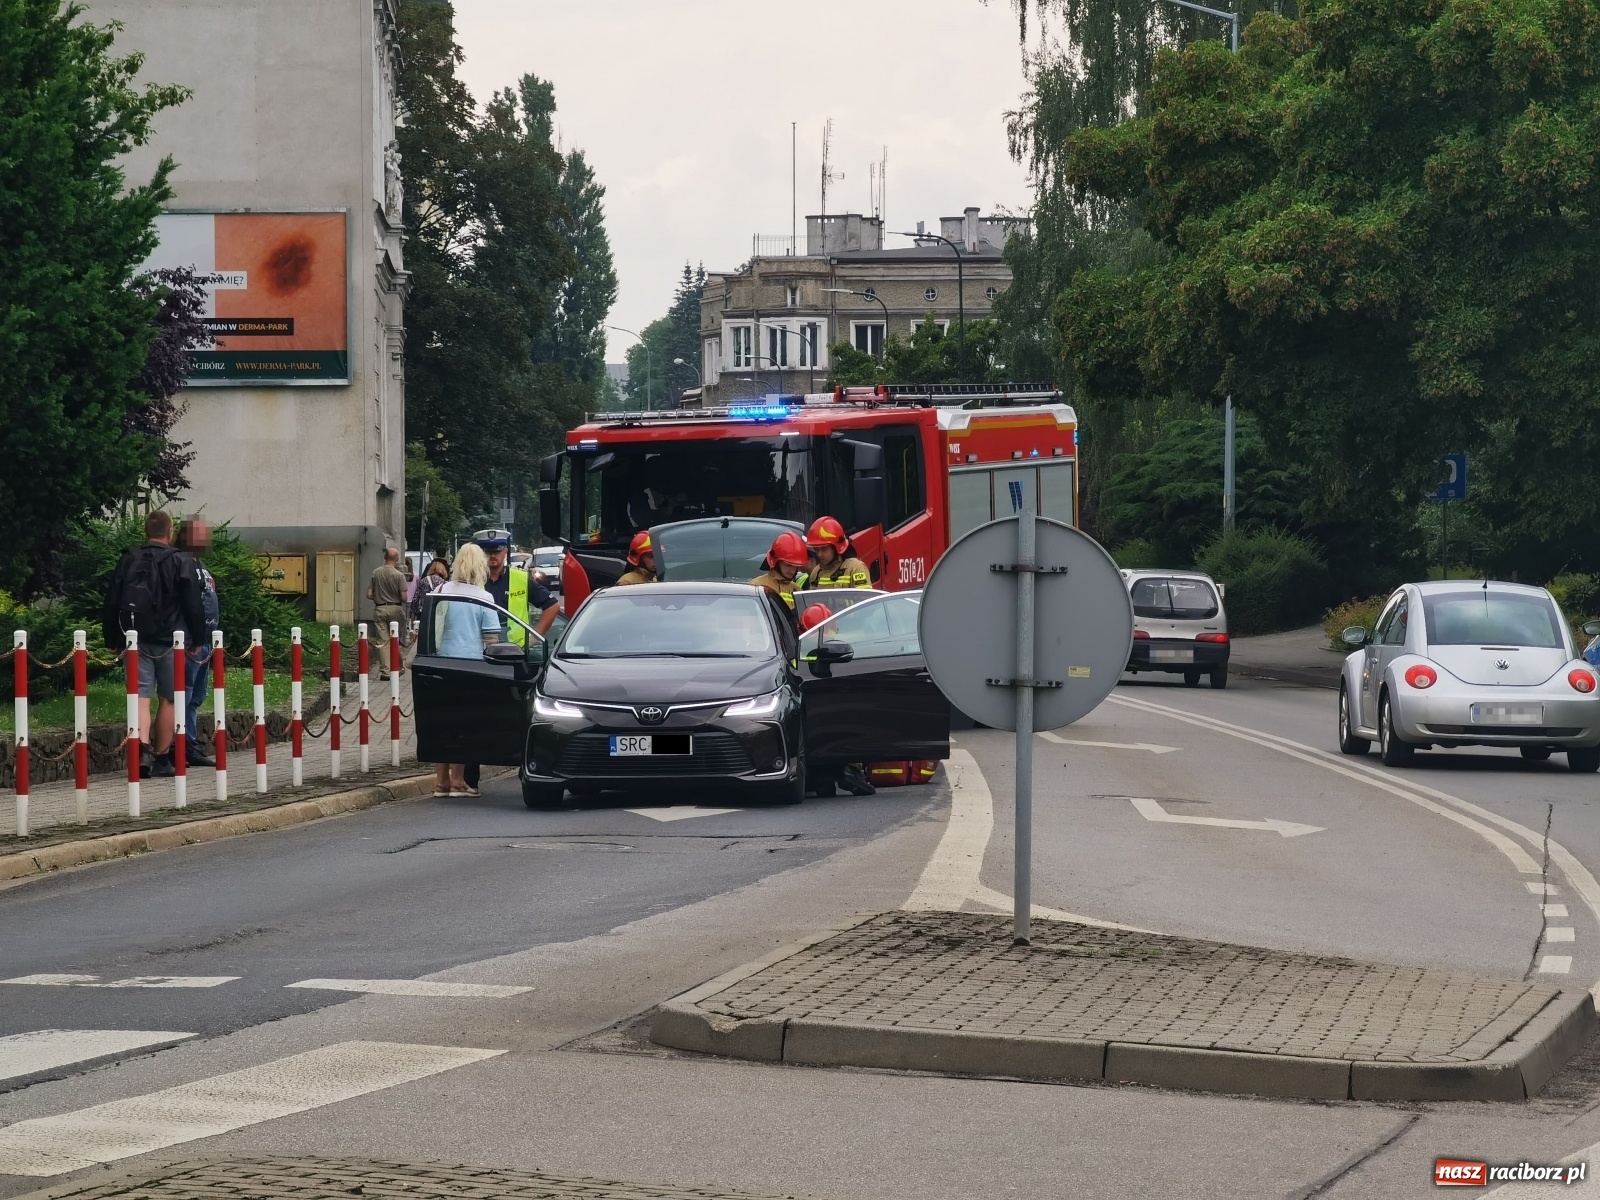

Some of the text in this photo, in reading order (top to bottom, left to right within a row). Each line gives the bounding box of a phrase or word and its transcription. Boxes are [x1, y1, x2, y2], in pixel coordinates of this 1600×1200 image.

[228, 323, 237, 331] W
[238, 323, 289, 331] DERMA-PARK
[235, 362, 322, 370] WWW.DERMA-PARK.PL
[619, 737, 648, 752] SRC
